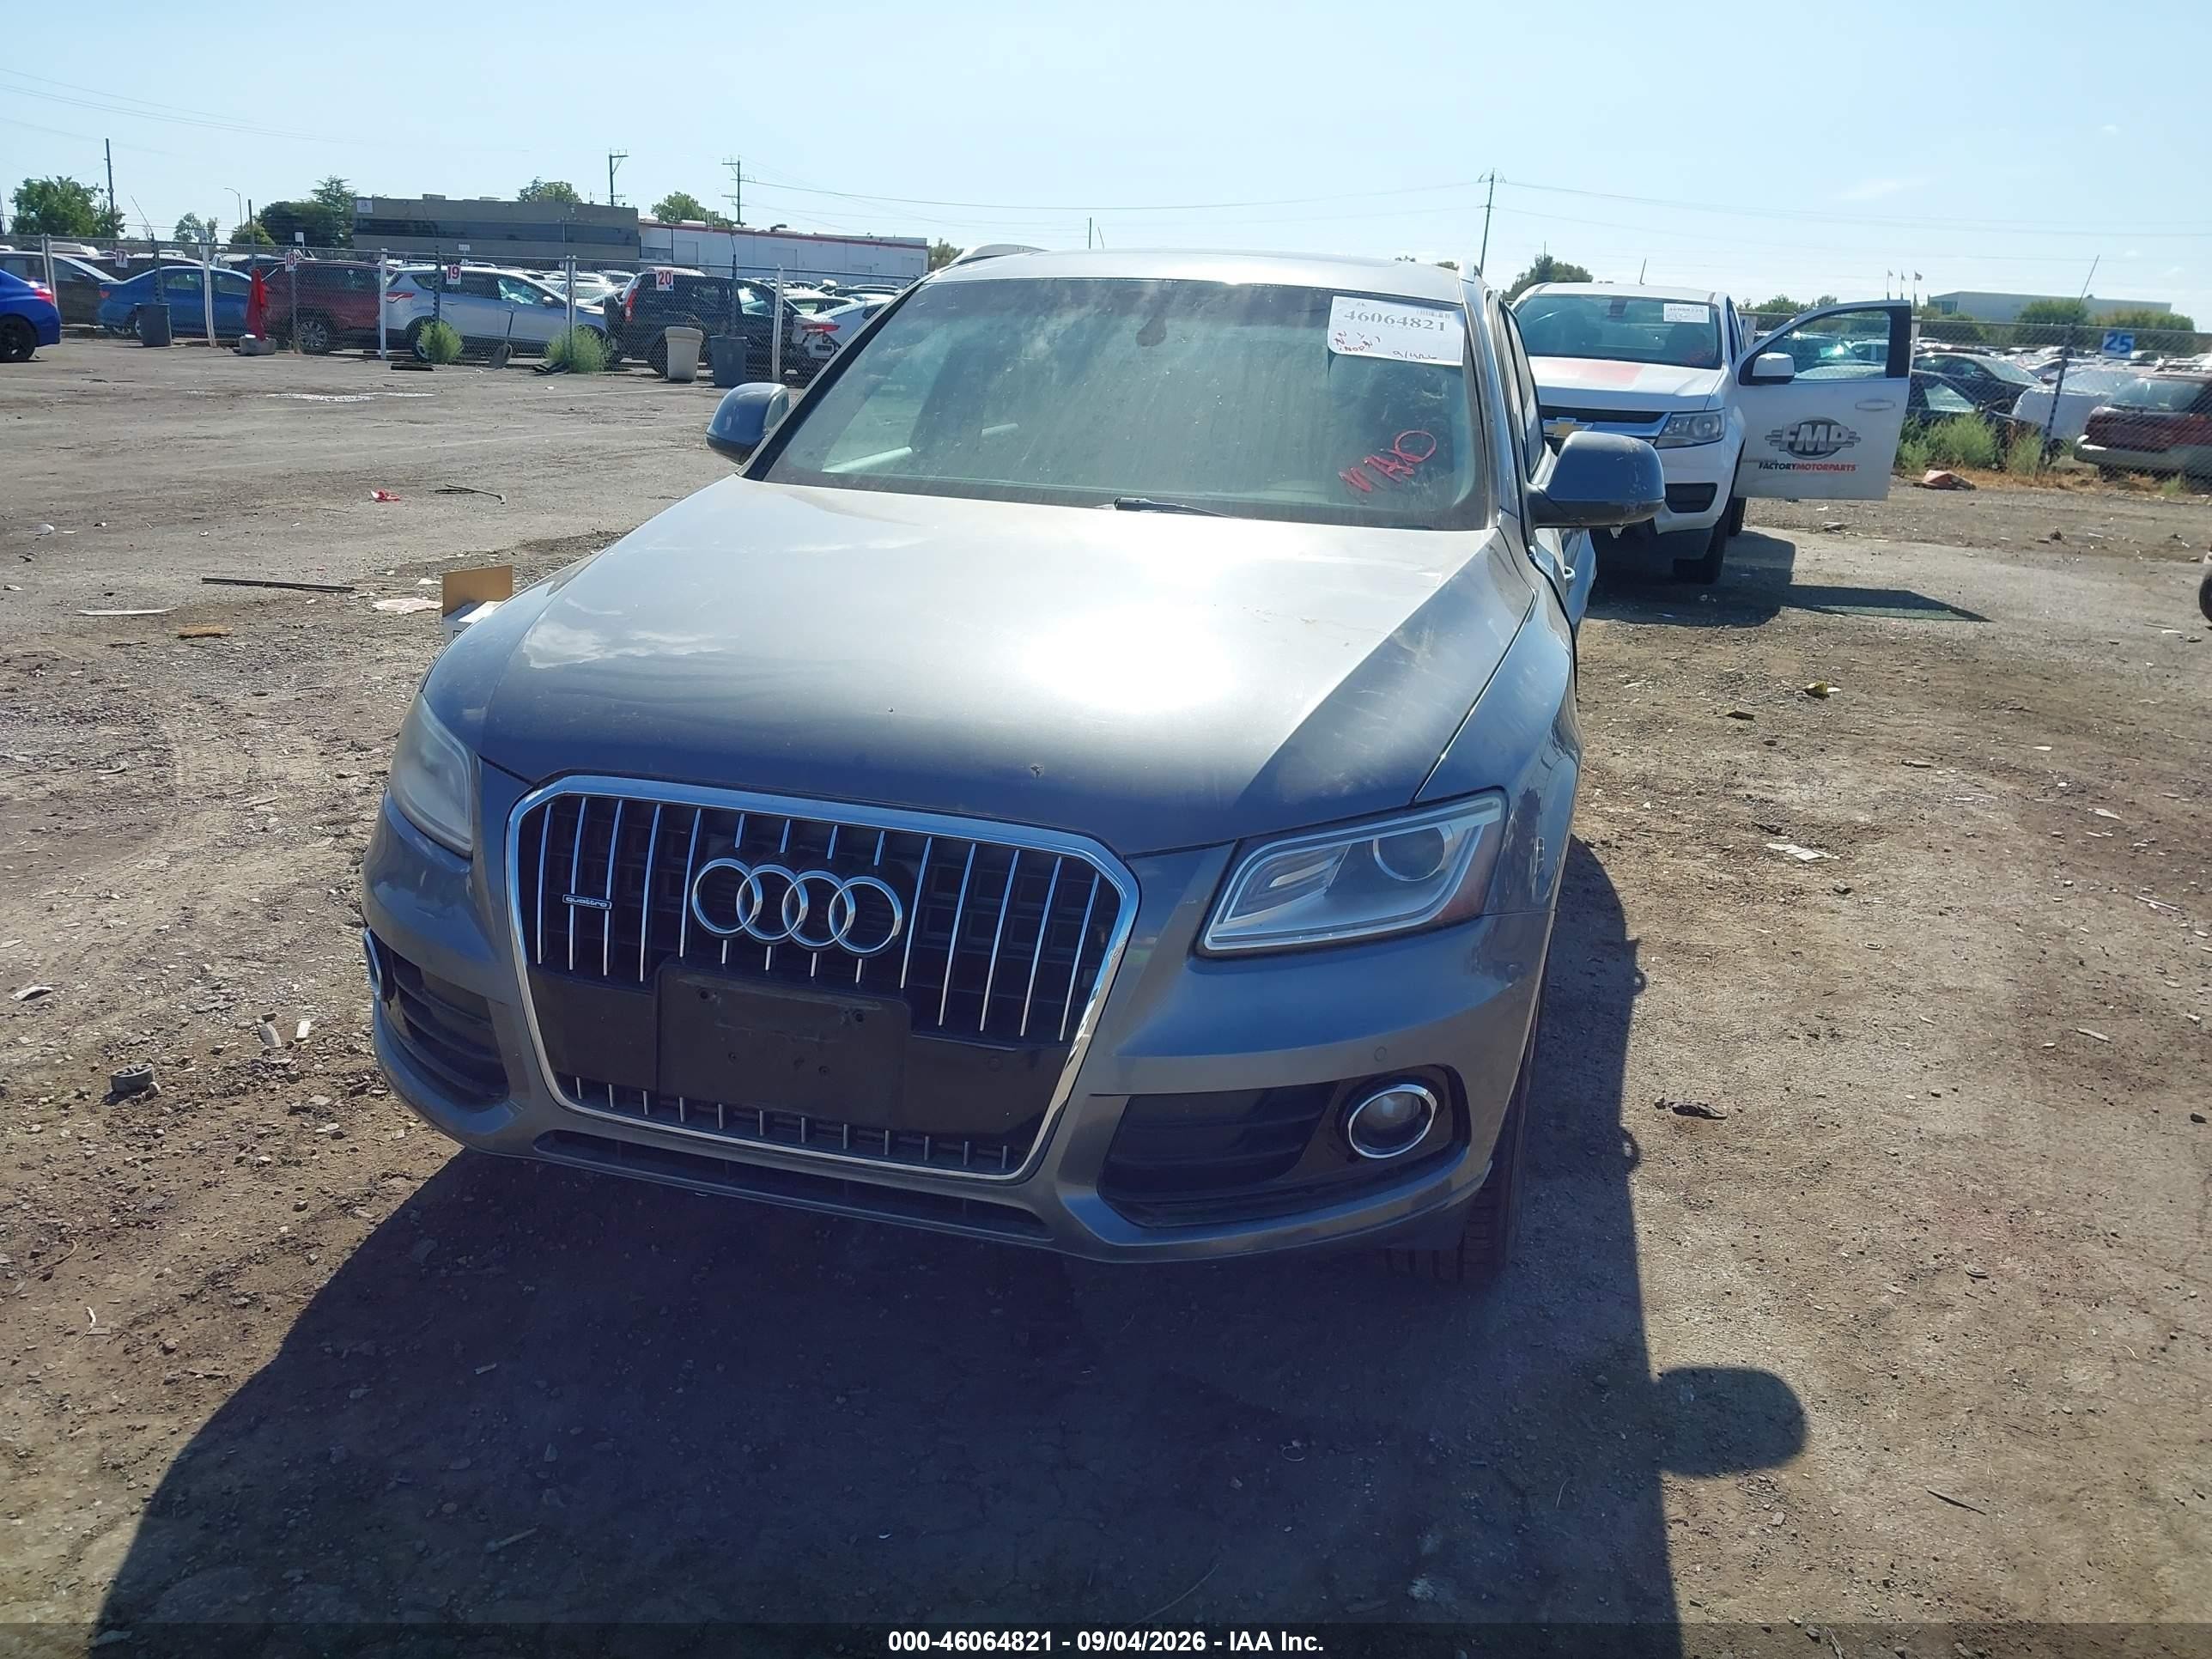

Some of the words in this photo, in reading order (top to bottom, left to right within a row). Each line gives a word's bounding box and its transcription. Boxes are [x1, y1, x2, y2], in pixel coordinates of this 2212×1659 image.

[285, 252, 295, 266] 18
[447, 266, 460, 279] 19
[658, 271, 672, 285] 20
[1344, 309, 1445, 331] 46064821
[2104, 331, 2133, 353] 25
[1779, 424, 1850, 452] FMP
[565, 896, 607, 908] quattro
